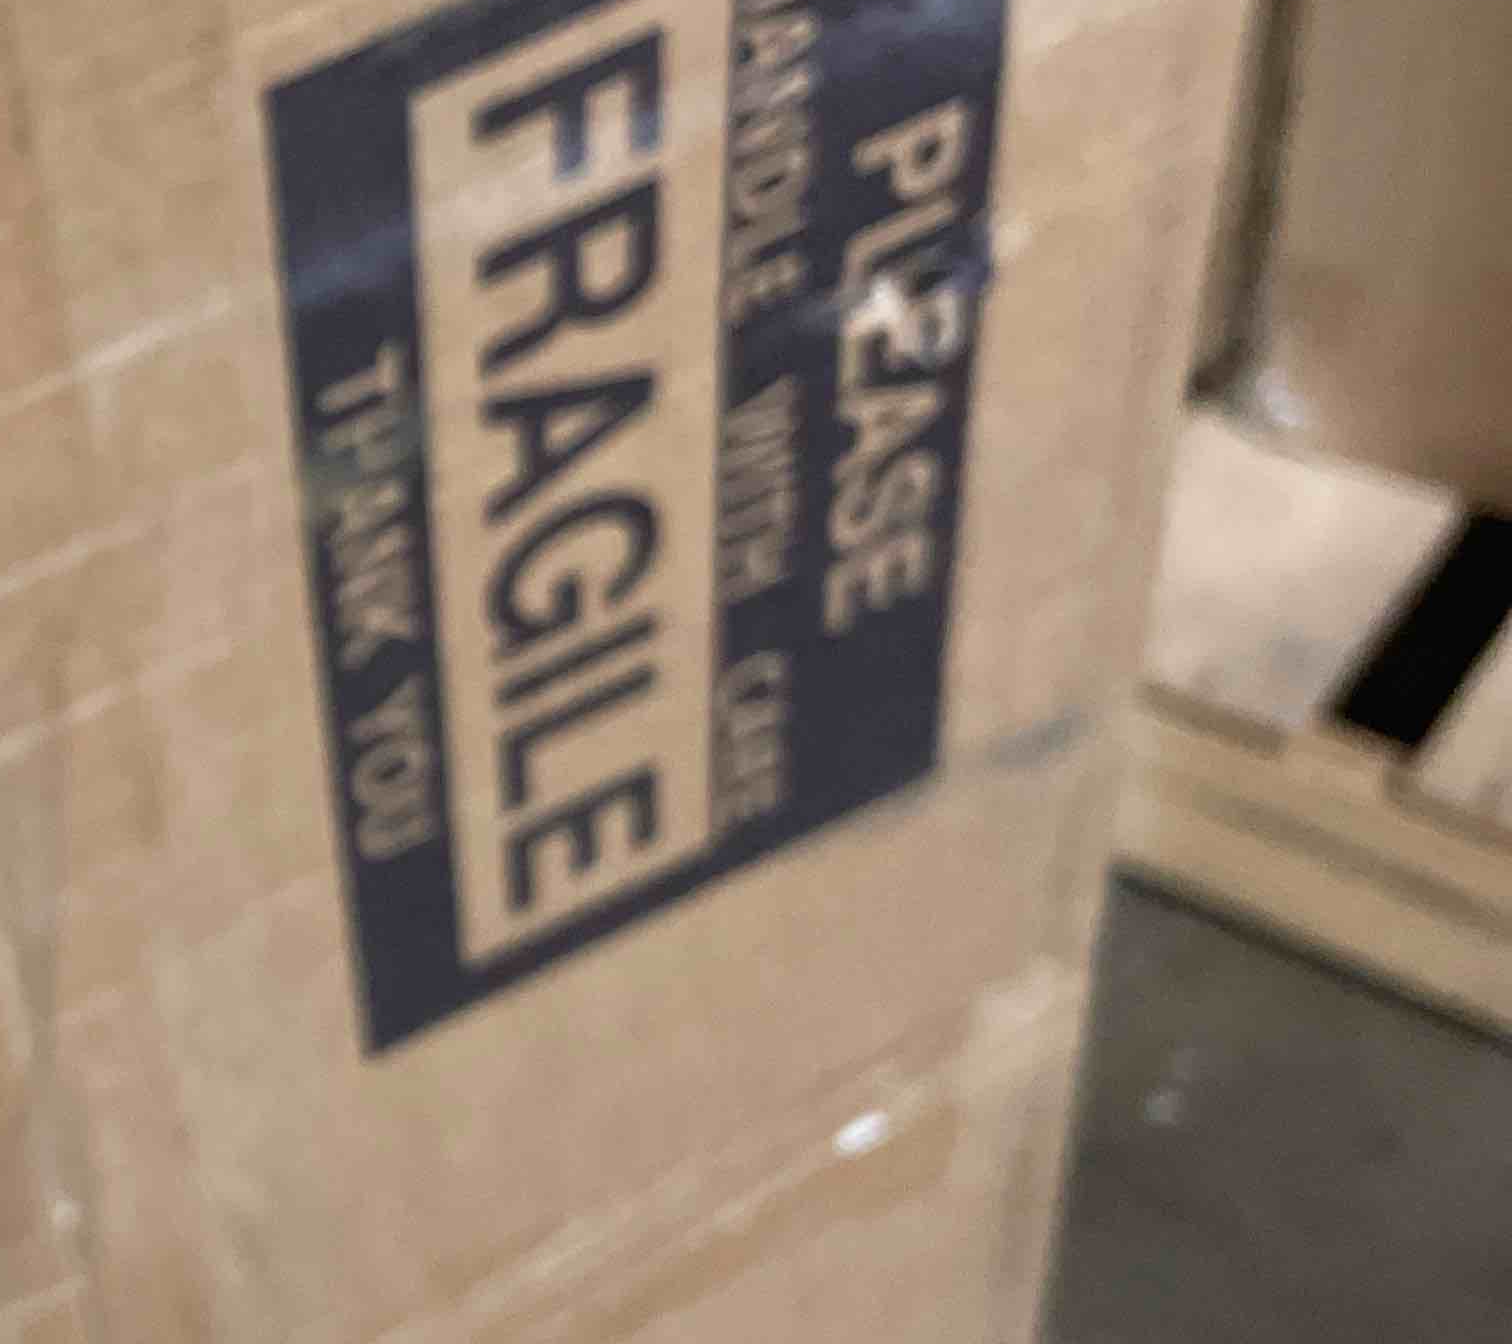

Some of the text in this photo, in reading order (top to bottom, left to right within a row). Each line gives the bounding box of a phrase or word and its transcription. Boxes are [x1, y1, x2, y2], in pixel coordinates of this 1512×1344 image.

[313, 341, 440, 862] THANK YOU
[472, 26, 668, 912] FRAGILE
[718, 372, 802, 608] WITH
[824, 96, 974, 636] PLEASE
